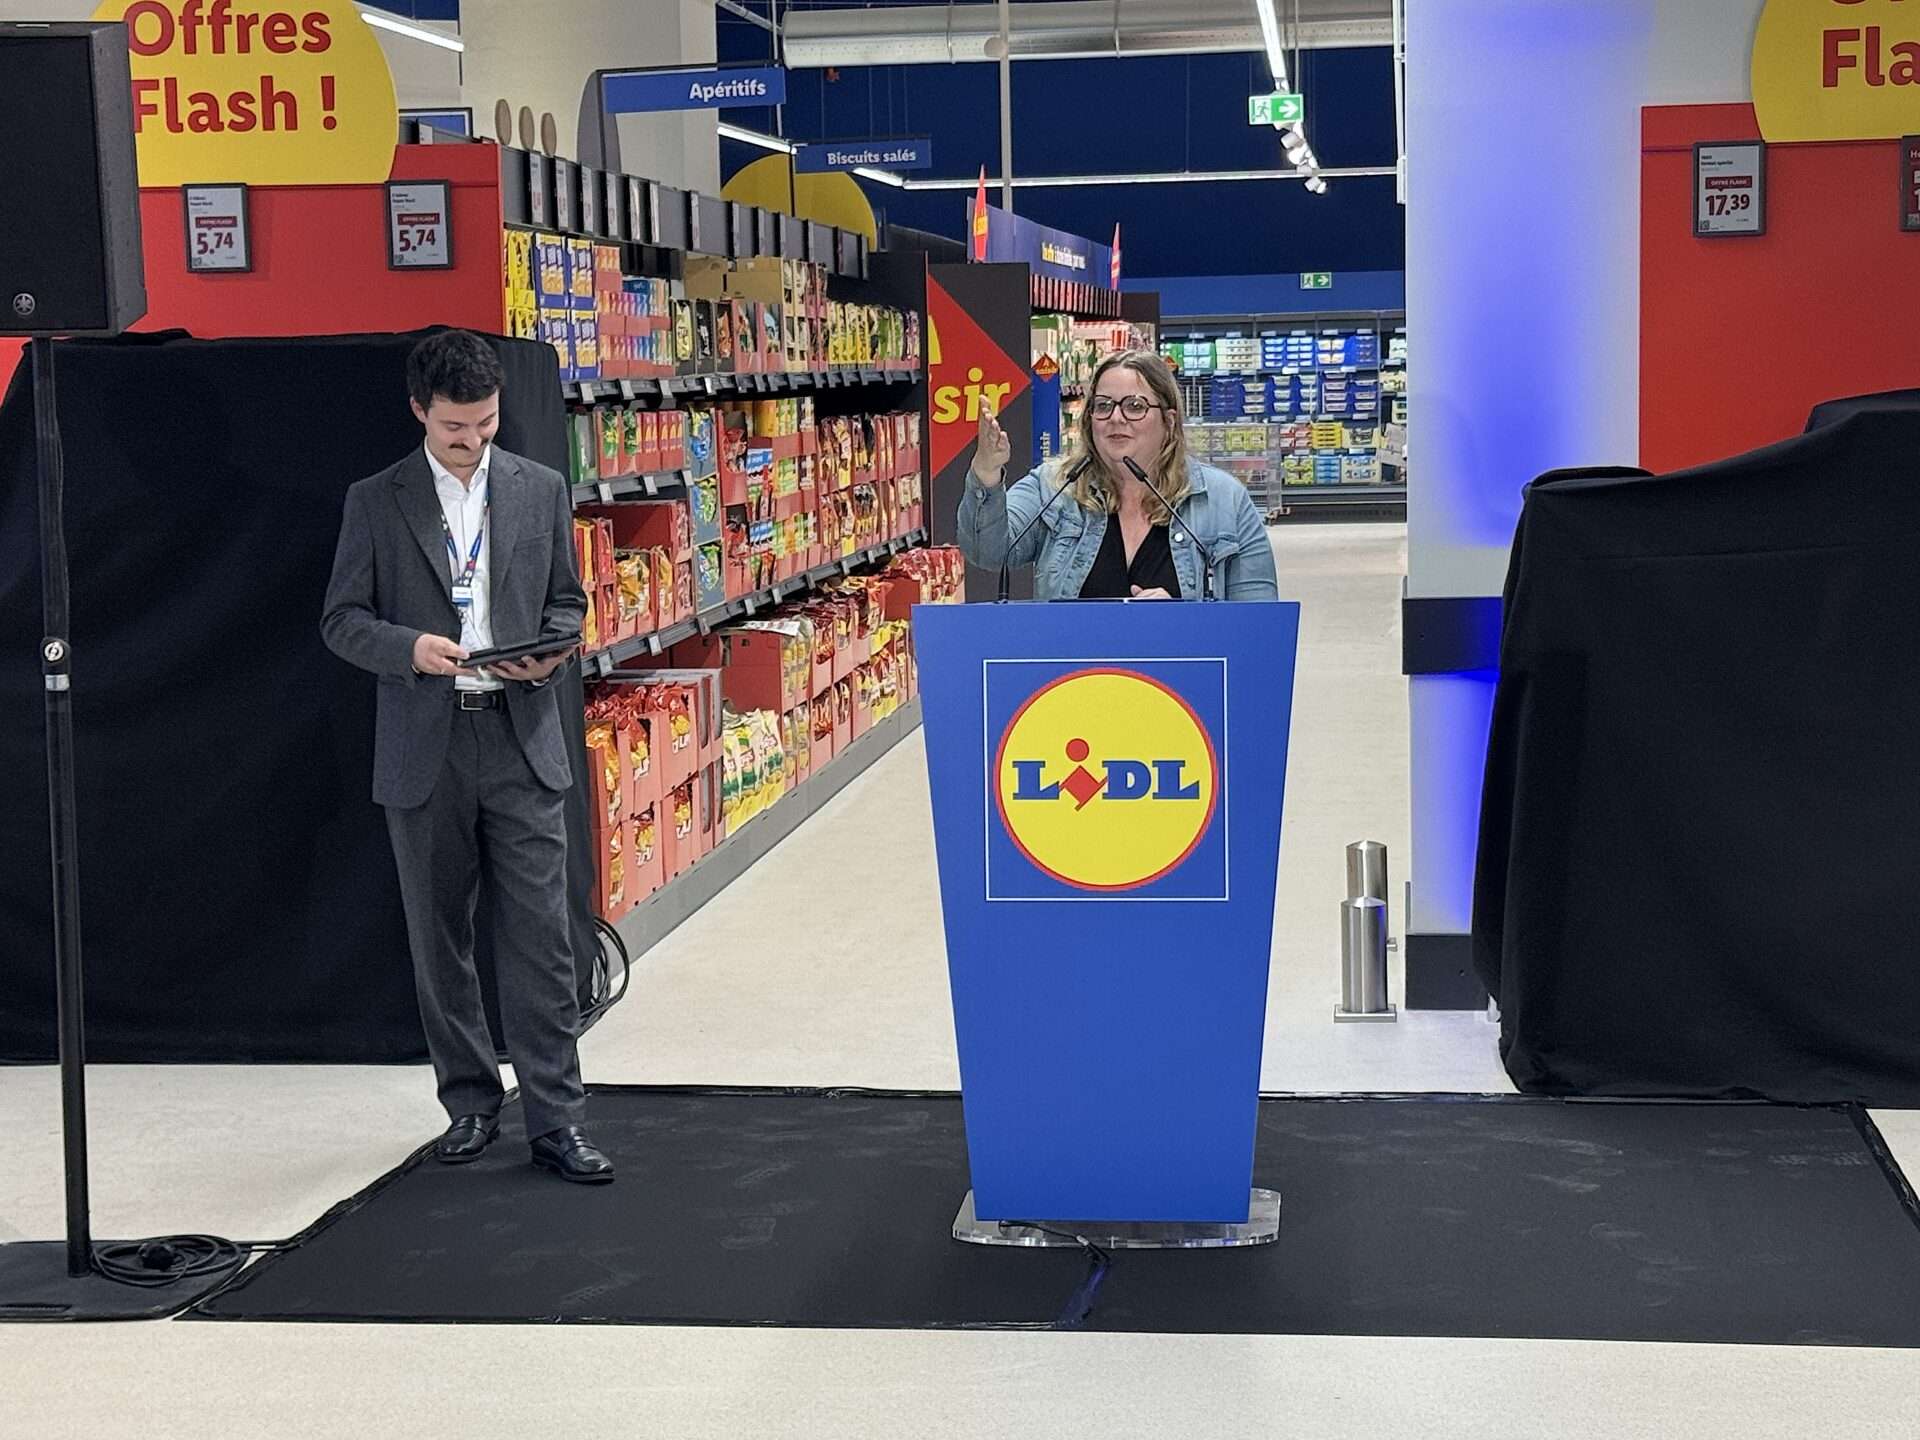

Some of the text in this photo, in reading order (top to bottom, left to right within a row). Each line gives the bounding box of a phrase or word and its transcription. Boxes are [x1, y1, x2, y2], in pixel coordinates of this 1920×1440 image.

[124, 0, 332, 56] Offres
[1822, 26, 1920, 88] Fla
[689, 79, 766, 102] Apéritifs
[131, 75, 337, 133] Flash !
[827, 148, 916, 165] Biscuits salés
[1705, 194, 1750, 216] 17.39
[197, 232, 234, 255] 5.74
[399, 229, 435, 252] 5.74
[928, 367, 1010, 424] sir
